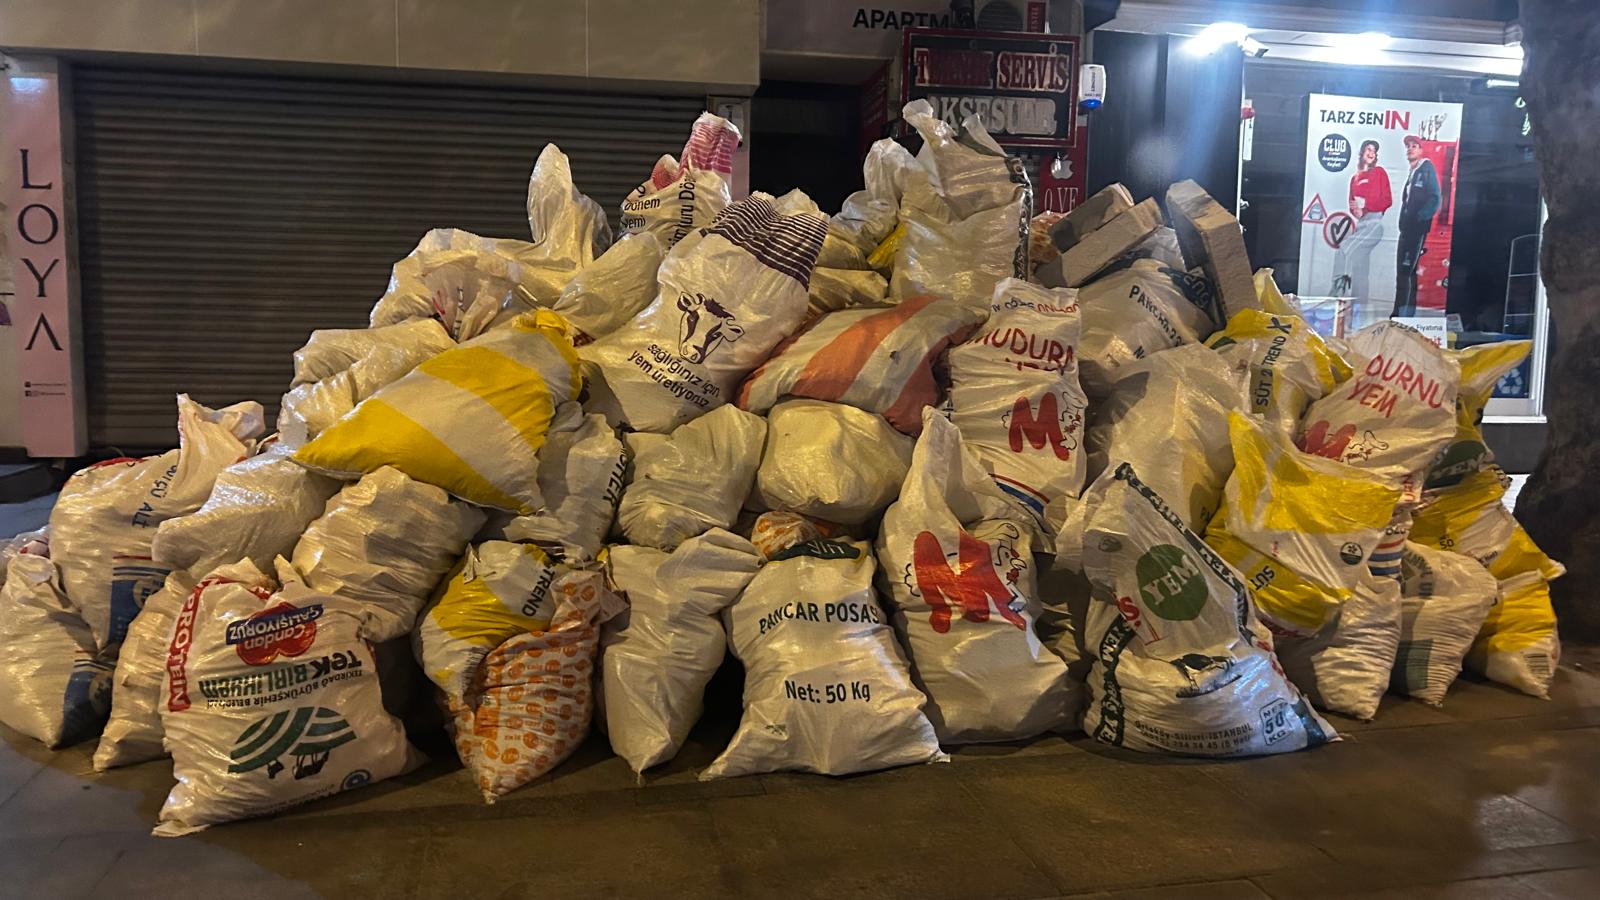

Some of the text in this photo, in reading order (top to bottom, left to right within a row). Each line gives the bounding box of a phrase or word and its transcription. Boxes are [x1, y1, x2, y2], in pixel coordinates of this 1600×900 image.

[1320, 109, 1355, 125] TARZ
[1323, 138, 1347, 152] CLUB
[677, 204, 693, 229] uru
[627, 349, 710, 409] yem üretiyoruz
[647, 343, 707, 387] sağlığınız
[1254, 378, 1270, 407] SÜT
[1262, 335, 1287, 368] TREND
[1347, 378, 1398, 419] YEM
[521, 566, 556, 618] TREND
[1142, 553, 1200, 606] YEM
[1250, 565, 1275, 591] SÜT
[229, 605, 320, 641] ÇALIŞIYORUZ
[758, 601, 820, 635] PANCAR
[244, 624, 306, 651] Candan
[253, 682, 319, 707] BÜYÜKŞEHİR
[784, 680, 871, 704] Net: 50 Kg
[1265, 711, 1284, 734] 50
